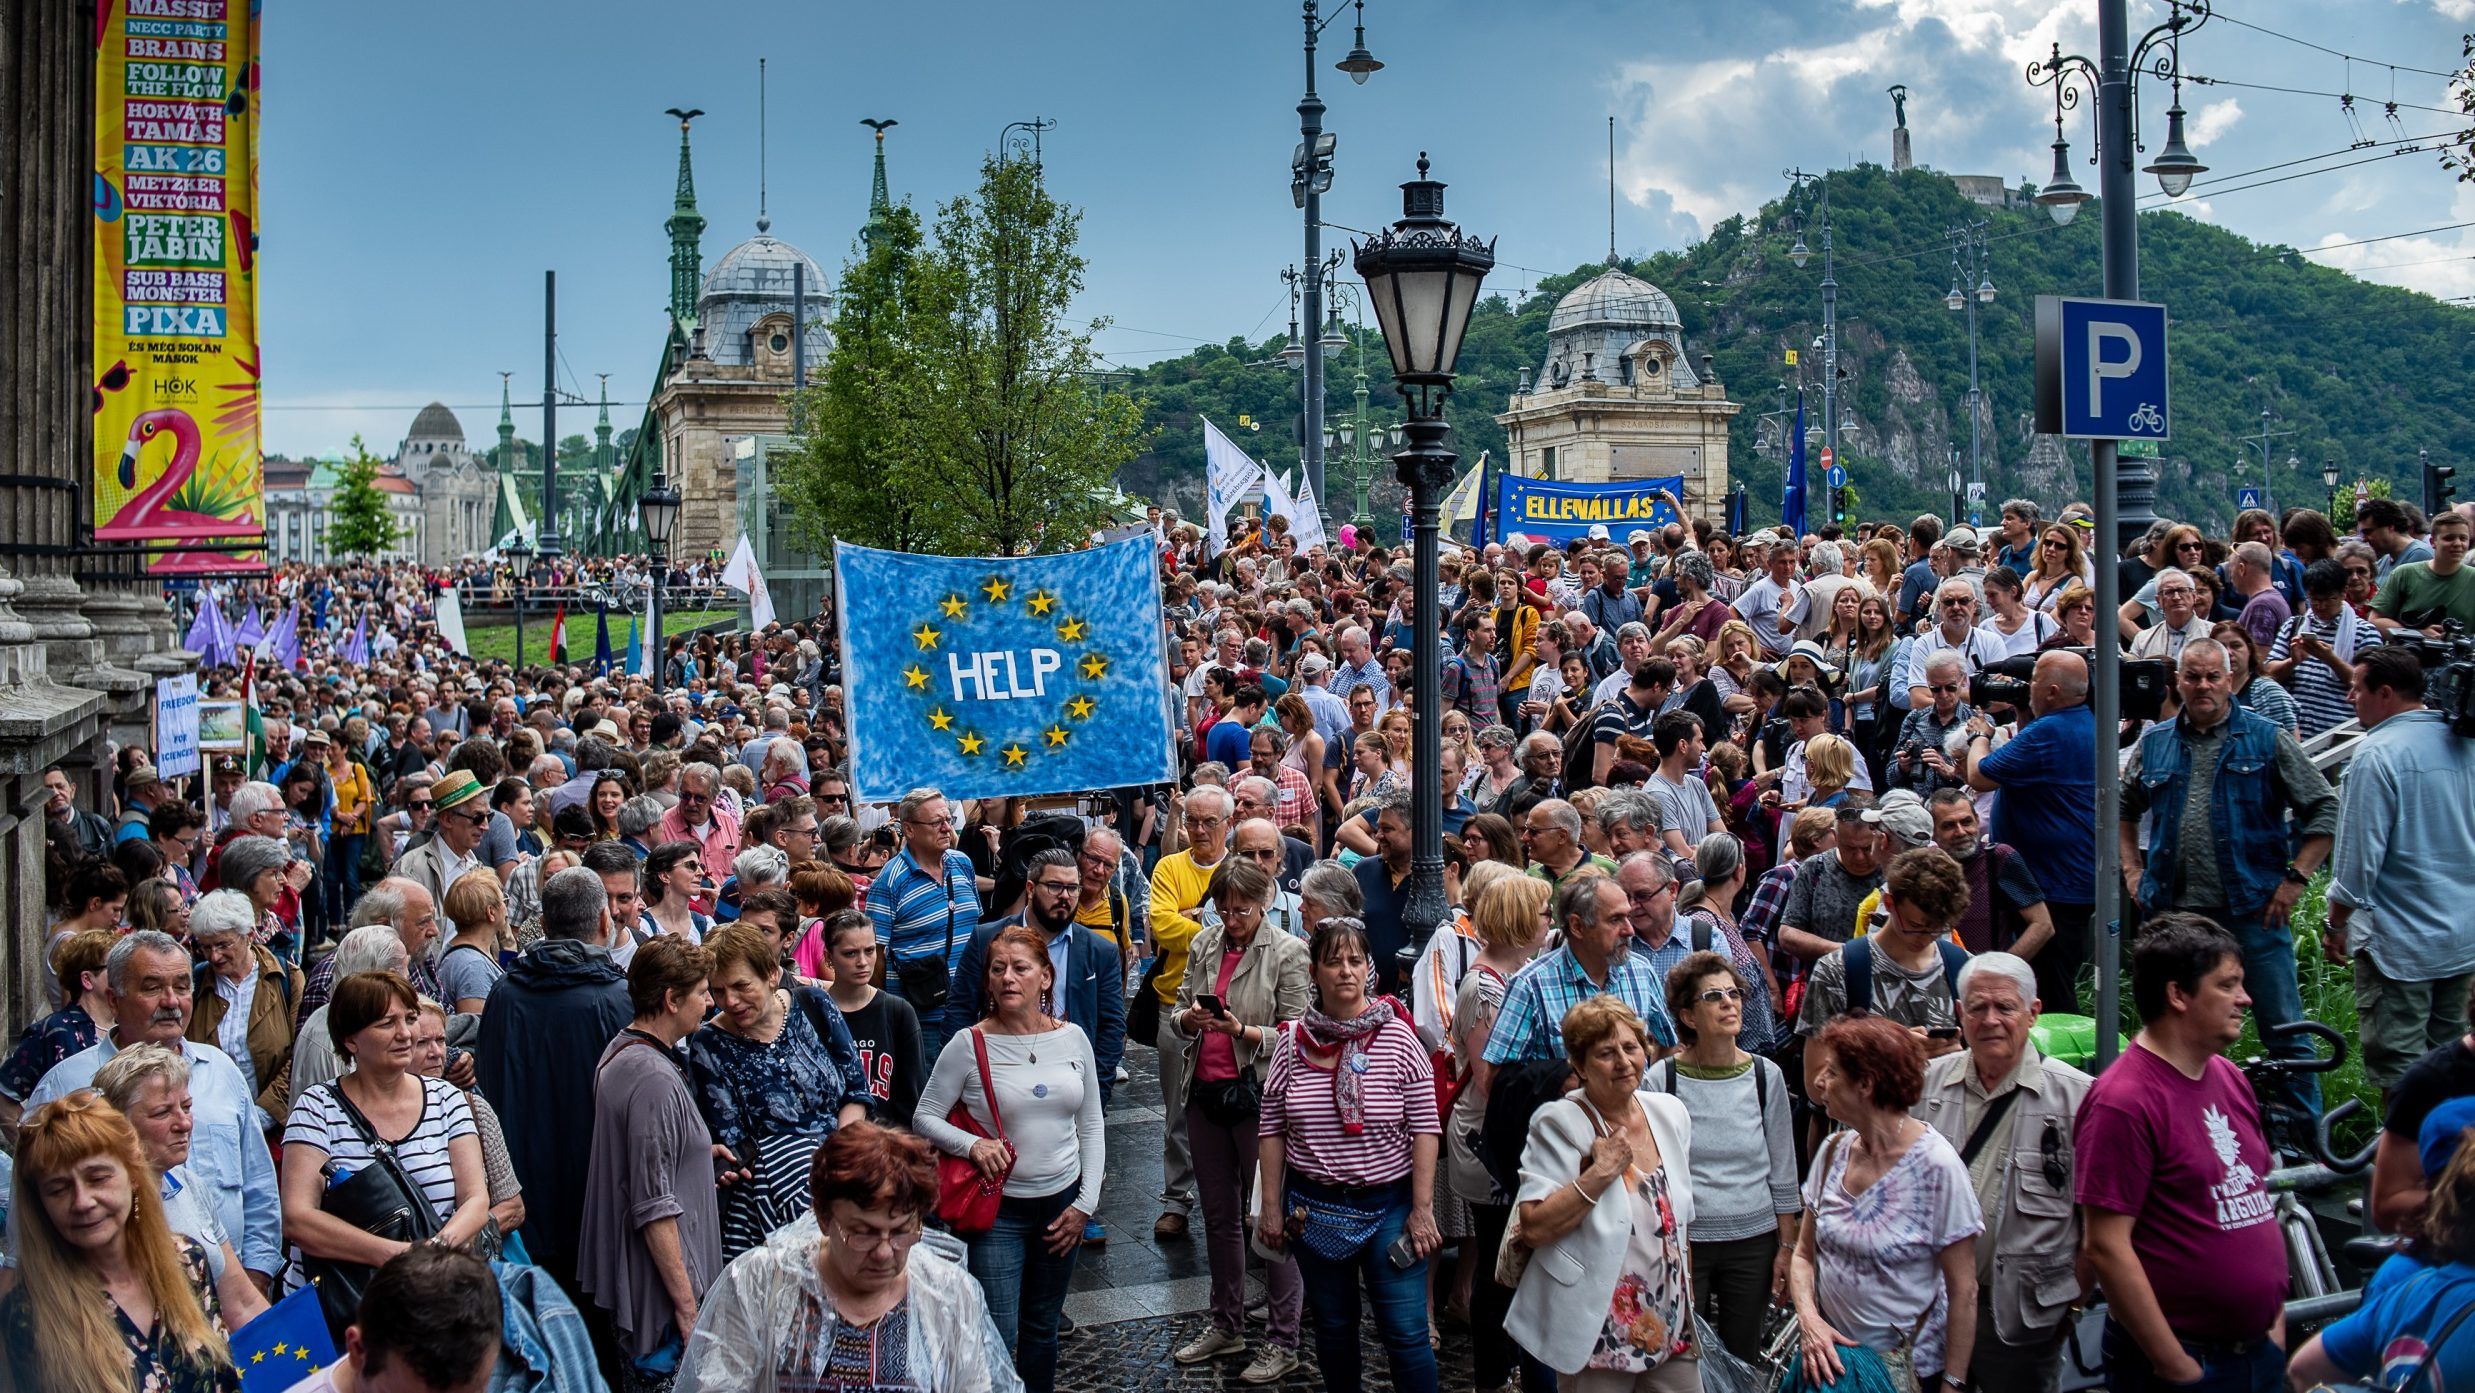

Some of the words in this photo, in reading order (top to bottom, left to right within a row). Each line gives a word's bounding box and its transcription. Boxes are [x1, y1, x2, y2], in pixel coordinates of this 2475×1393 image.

[129, 22, 171, 35] NECC
[175, 24, 223, 37] PARTY
[128, 39, 223, 60] BRAINS
[128, 63, 223, 84] FOLLOW
[128, 81, 167, 95] THE
[171, 83, 223, 98] FLOW
[127, 102, 223, 122] HORVÁTH
[127, 119, 222, 143] TAMÁS
[128, 146, 179, 170] AK
[187, 149, 222, 172] 26
[128, 176, 222, 193] METZKER
[128, 192, 221, 210] VIKTÓRIA
[127, 215, 222, 238] PETER
[127, 236, 221, 264] JABIN
[127, 271, 166, 286] SUB
[170, 272, 222, 288] BASS
[127, 287, 223, 303] MONSTER
[127, 307, 222, 335] PIXA
[128, 340, 144, 352] ÉS
[147, 341, 175, 352] MÉG
[178, 343, 222, 353] SOKAN
[152, 353, 199, 364] MÁSOK
[2088, 320, 2142, 417] P
[1525, 493, 1655, 520] ELLENÁLLÁS
[948, 648, 1061, 701] HELP
